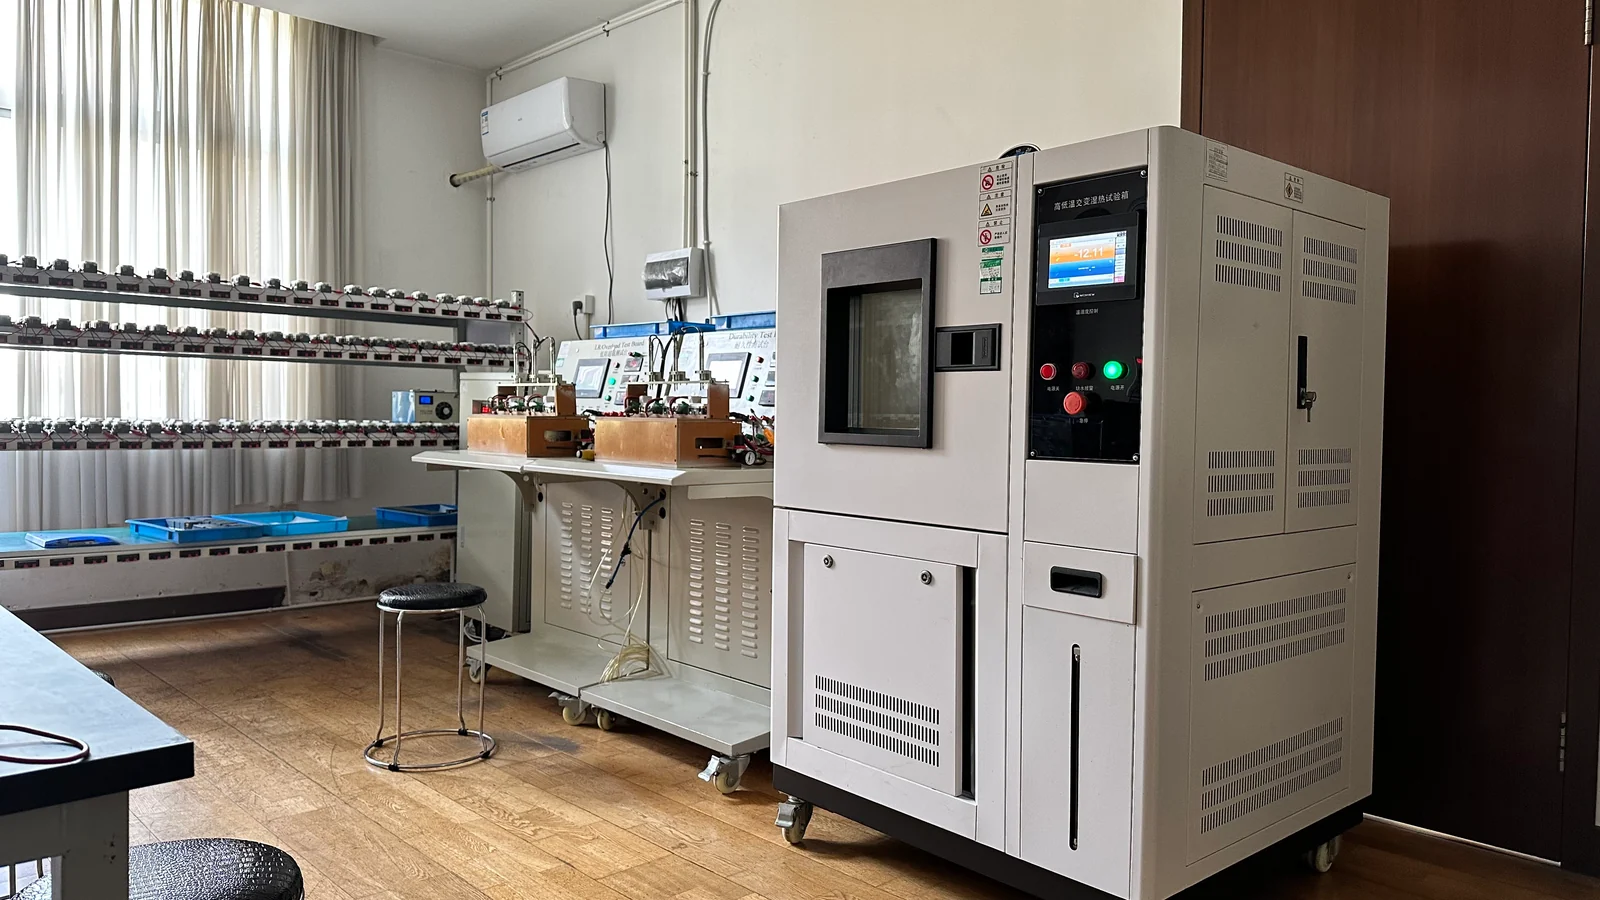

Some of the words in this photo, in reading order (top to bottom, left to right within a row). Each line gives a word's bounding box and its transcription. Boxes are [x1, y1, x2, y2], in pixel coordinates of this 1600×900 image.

[1054, 190, 1129, 211] 高低温交变湿热试验箱
[1074, 246, 1103, 258] -12.11
